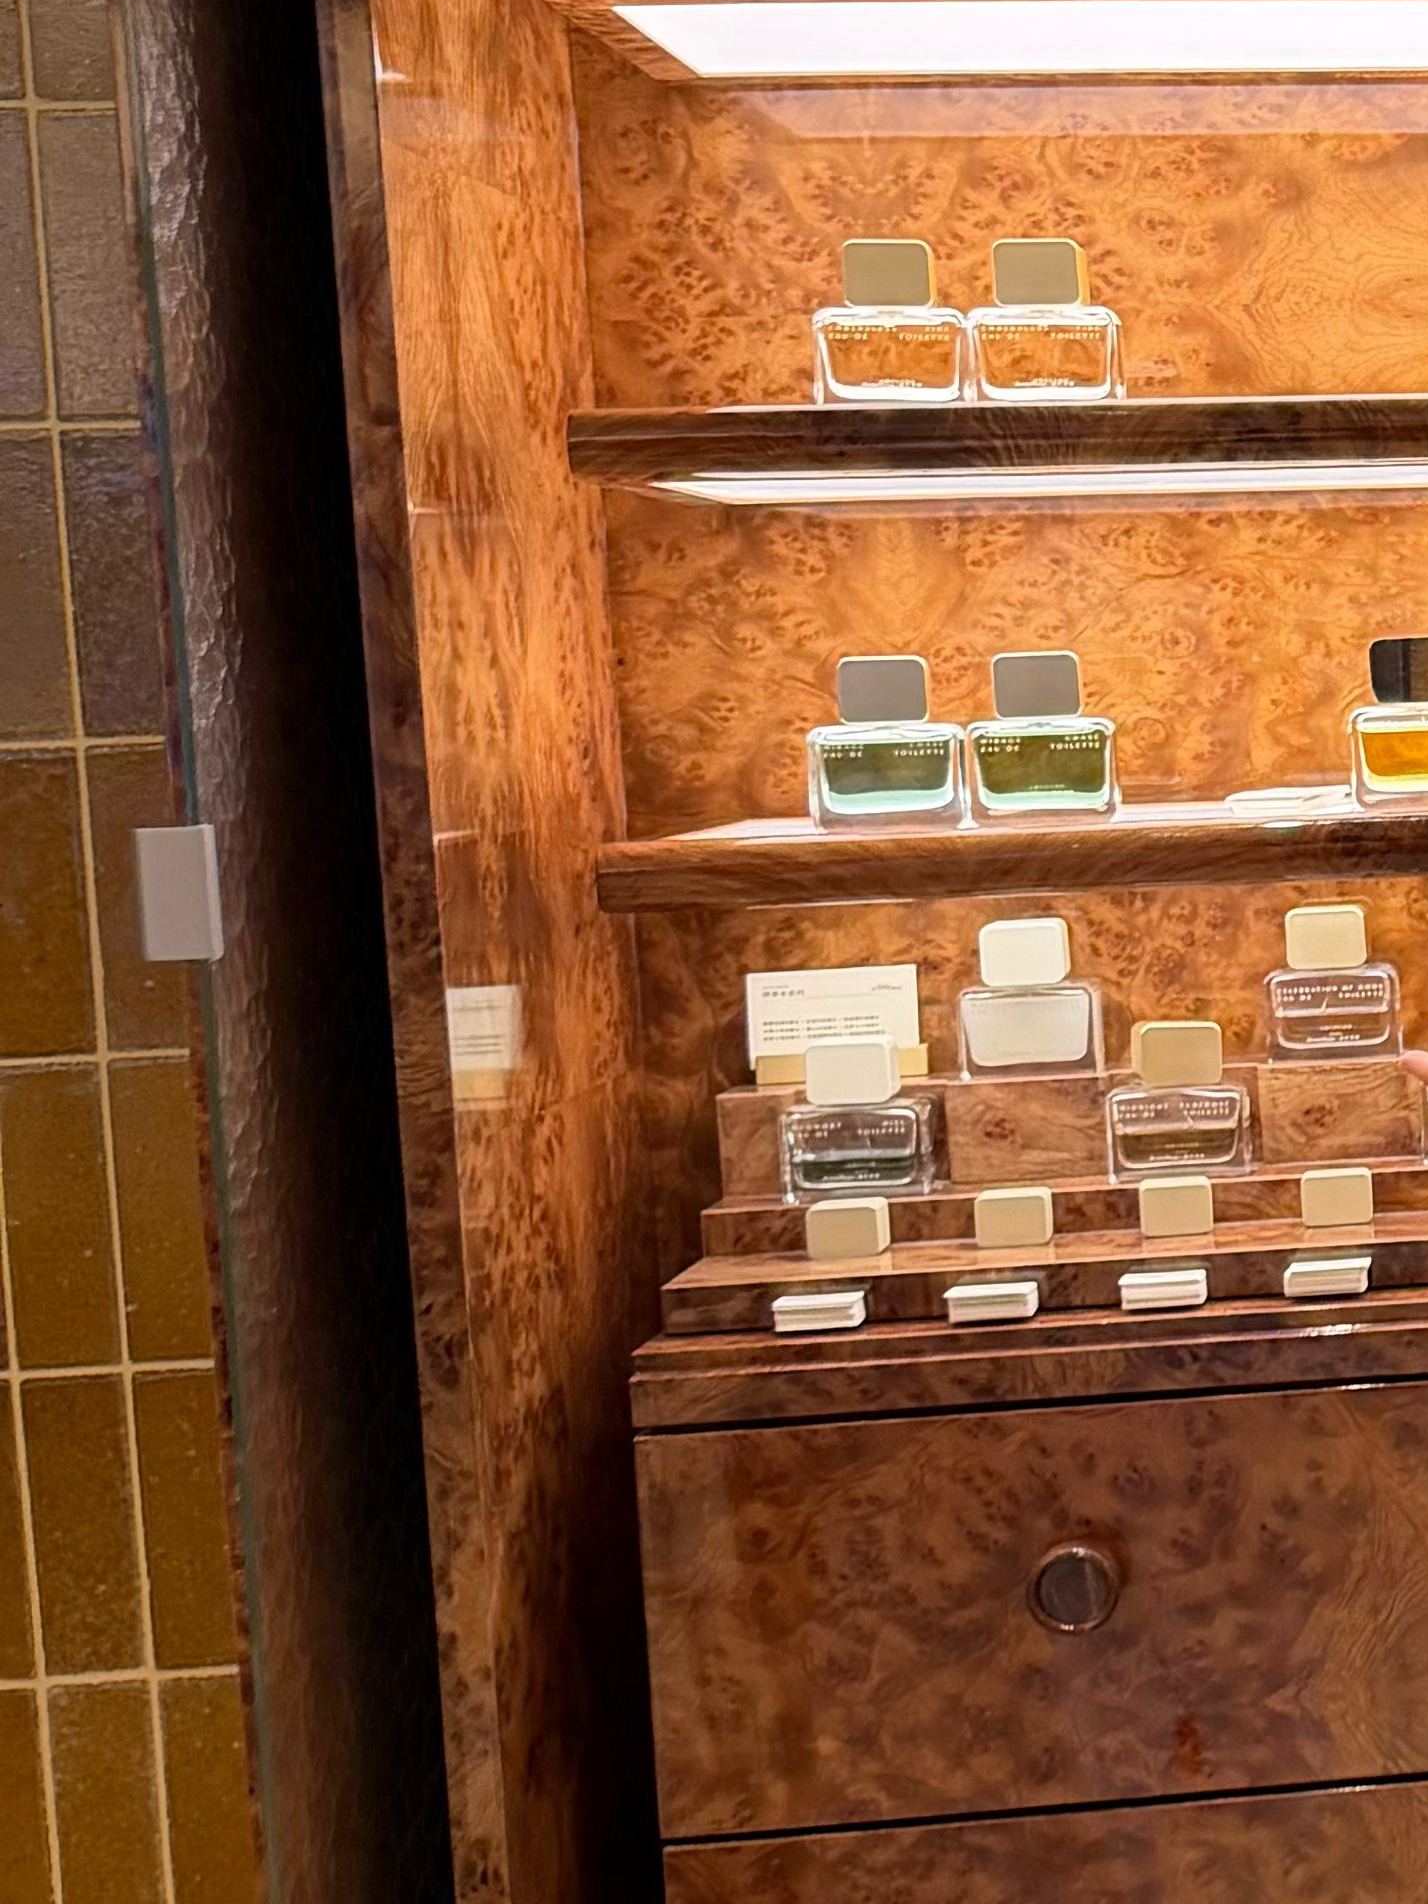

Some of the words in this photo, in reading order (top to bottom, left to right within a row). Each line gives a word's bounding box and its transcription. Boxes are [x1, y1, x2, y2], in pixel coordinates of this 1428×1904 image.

[980, 745, 1001, 753] EAU
[1006, 745, 1020, 753] DE
[1050, 742, 1100, 751] TOILETTE
[894, 749, 944, 757] TOILETTE
